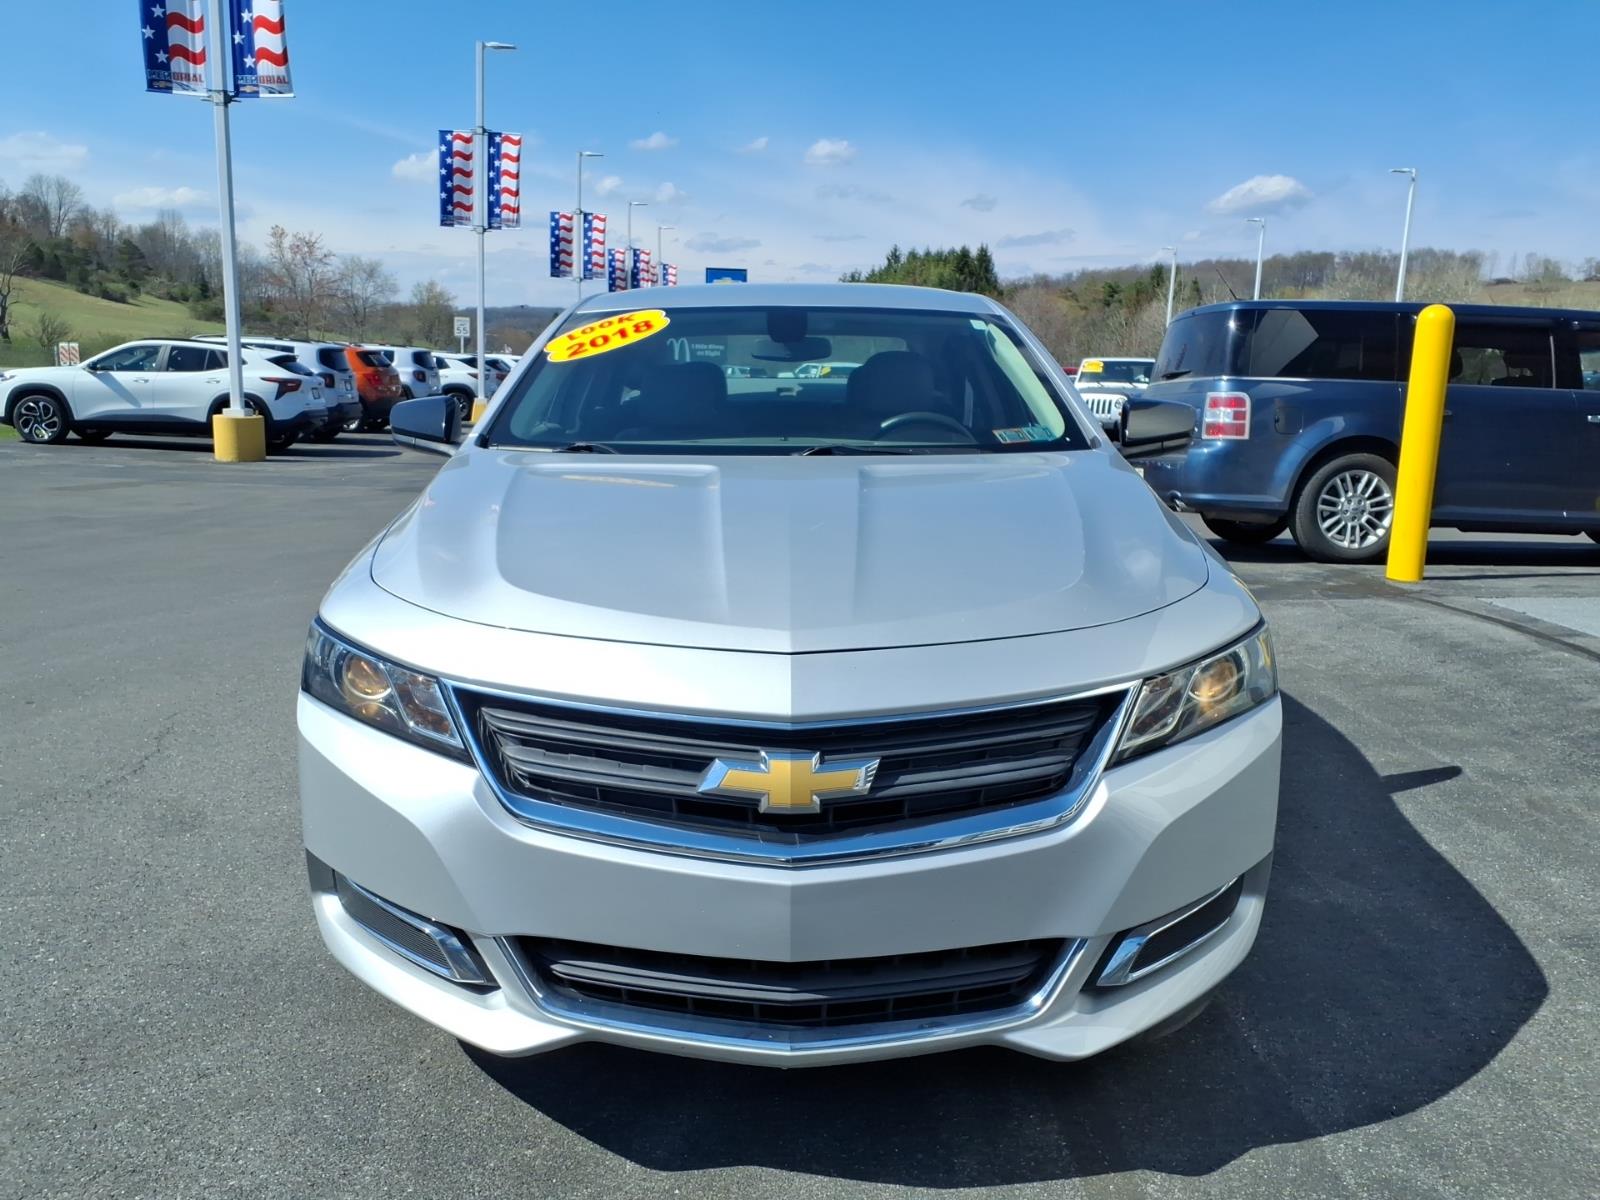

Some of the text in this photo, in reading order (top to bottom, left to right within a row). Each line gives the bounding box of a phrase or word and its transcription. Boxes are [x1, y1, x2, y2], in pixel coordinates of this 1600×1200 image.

[147, 69, 205, 83] MEMORIAL
[235, 75, 289, 85] MEMORIAL
[456, 326, 469, 335] 55
[566, 314, 636, 341] LOOK
[566, 320, 654, 358] 2018
